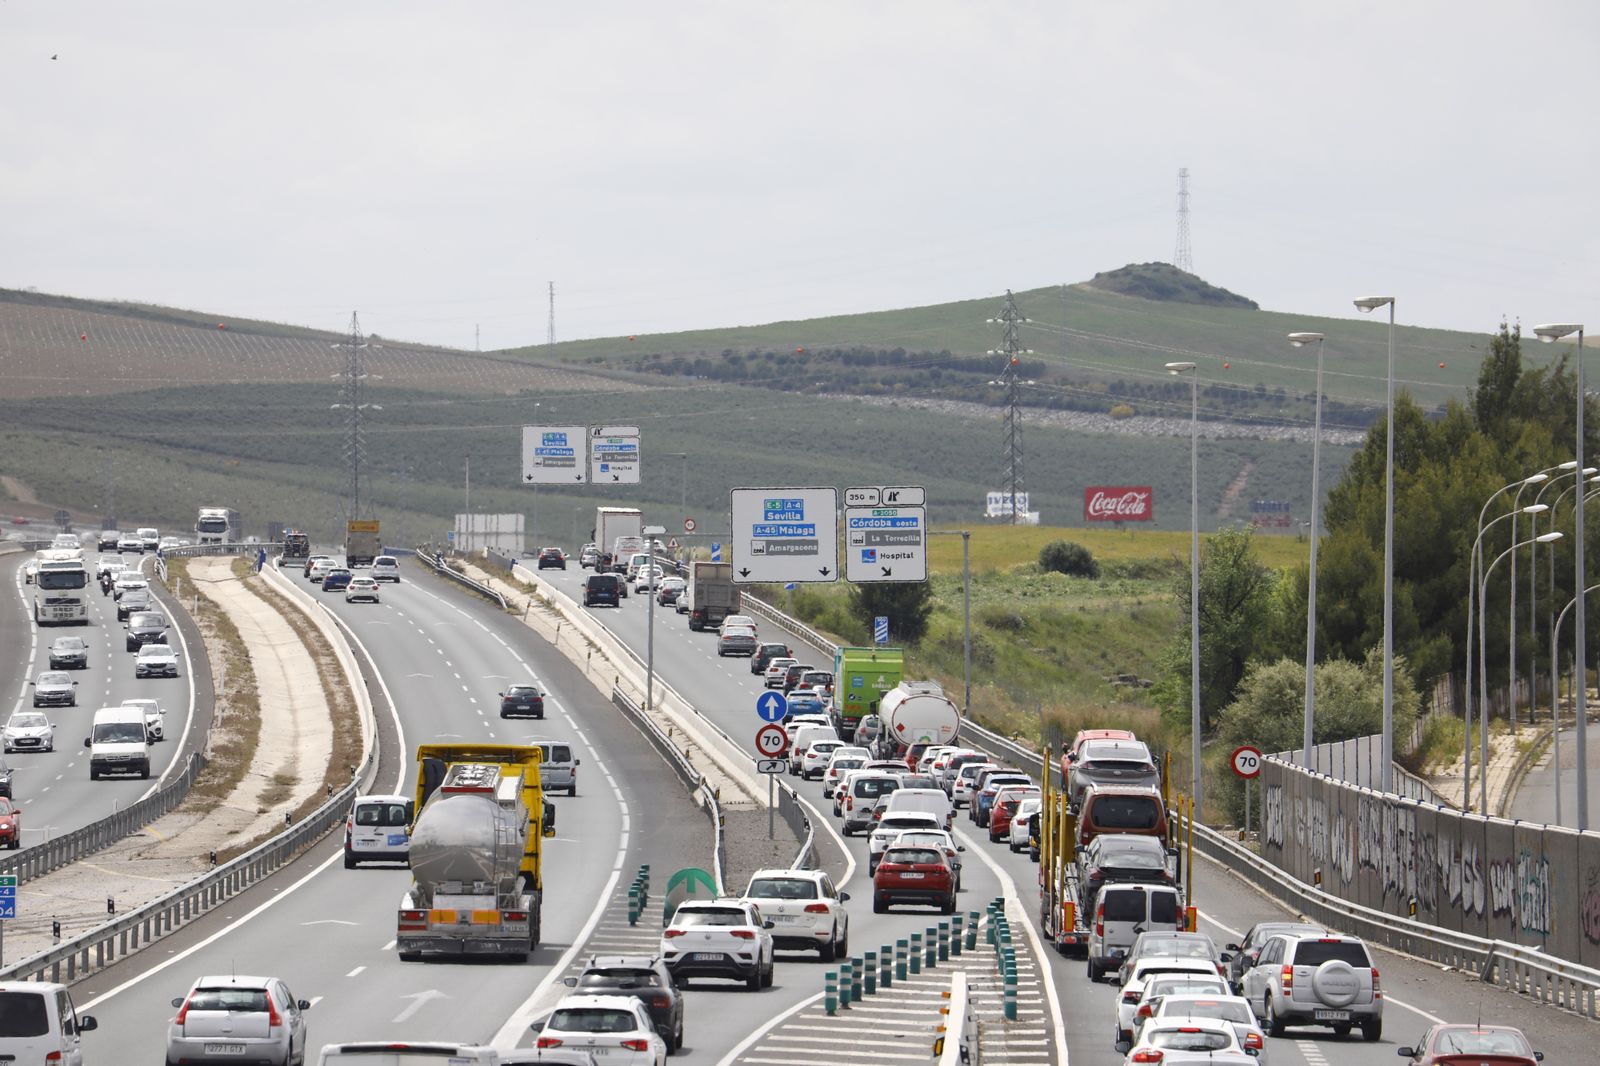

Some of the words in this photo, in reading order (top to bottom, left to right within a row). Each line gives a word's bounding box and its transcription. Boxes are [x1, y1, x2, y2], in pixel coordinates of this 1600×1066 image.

[1089, 492, 1148, 515] Coca-Cola
[767, 512, 801, 520] Sevilla
[851, 518, 892, 527] Córdoba
[756, 526, 776, 534] A-45
[779, 526, 814, 535] Málaga
[885, 534, 920, 542] Torrecilla
[769, 544, 817, 552] Amargacena
[880, 551, 914, 560] Hospital
[763, 735, 781, 746] 70
[1239, 756, 1257, 768] 70
